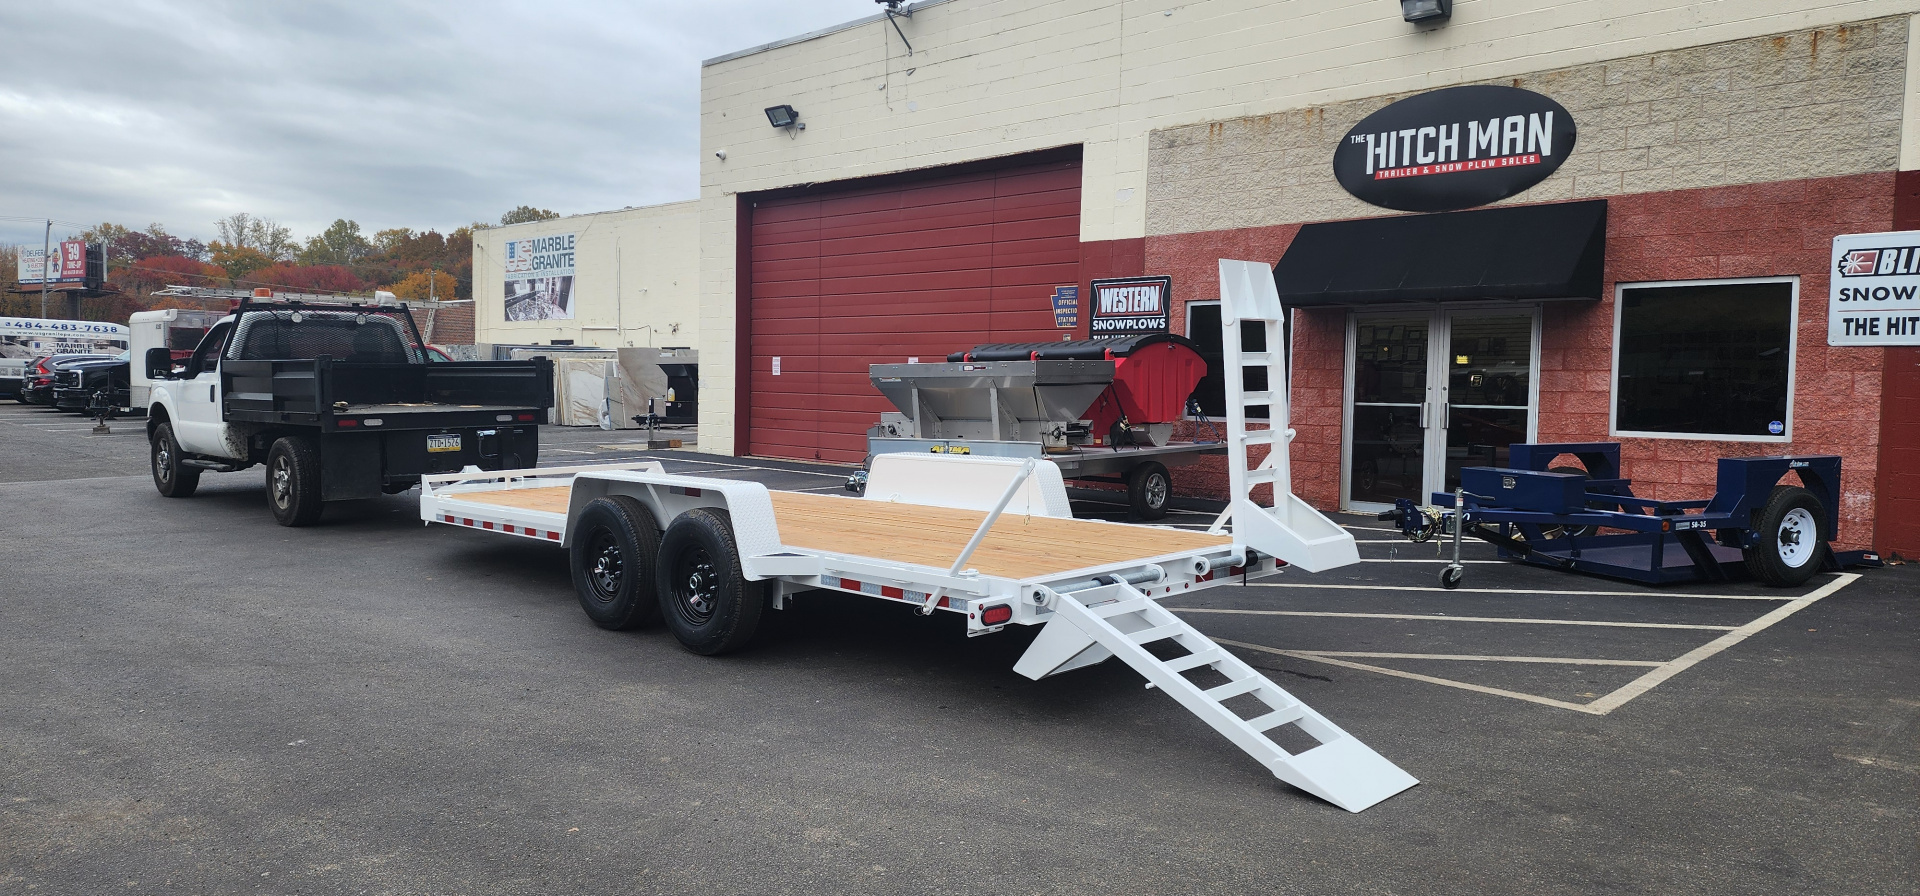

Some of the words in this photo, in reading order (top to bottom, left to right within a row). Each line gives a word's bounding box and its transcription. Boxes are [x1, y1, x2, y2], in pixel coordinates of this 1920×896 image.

[1351, 134, 1366, 144] THE
[1366, 123, 1459, 175] HITCH
[1468, 111, 1554, 159] MAN
[1379, 167, 1417, 178] TRAILER
[1423, 166, 1429, 174] &
[1435, 163, 1462, 173] SNOW
[1468, 160, 1496, 169] PLOW
[1502, 155, 1535, 166] SALES
[532, 235, 575, 253] MARBLE
[505, 240, 531, 272] US
[532, 252, 575, 270] GRANITE
[540, 269, 575, 277] INSTALLATION
[1100, 285, 1160, 314] WESTERN
[14, 321, 118, 333] 484-483-7638
[1092, 318, 1166, 330] SNOWPLOWS
[1843, 317, 1880, 336] THE
[1887, 316, 1920, 336] HIT
[56, 342, 93, 350] MARBLE
